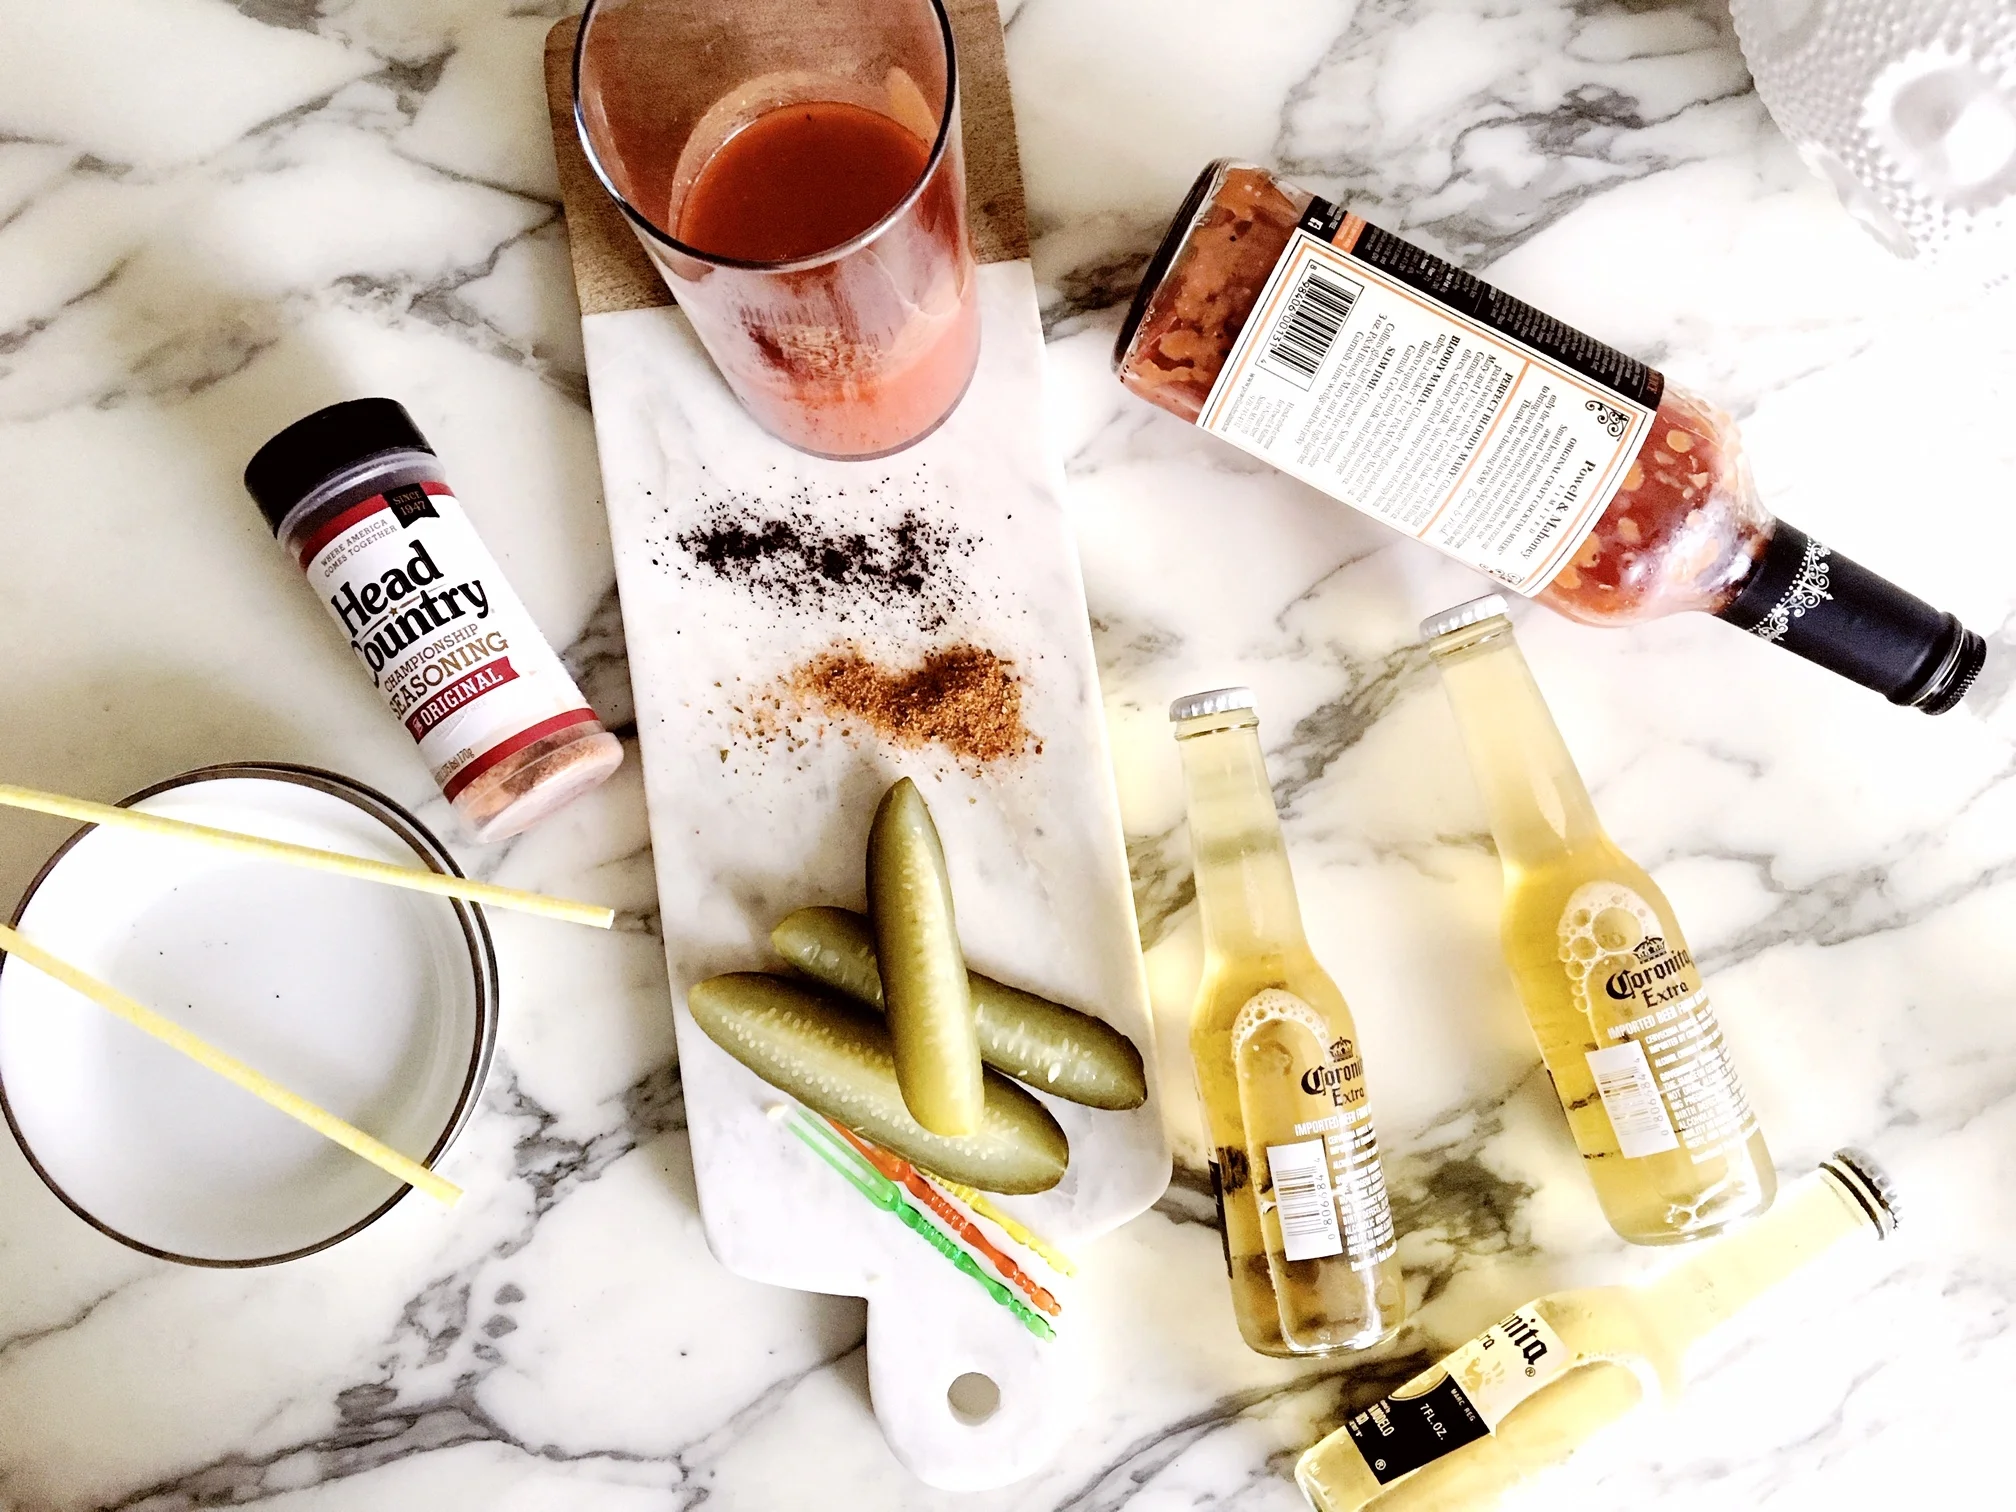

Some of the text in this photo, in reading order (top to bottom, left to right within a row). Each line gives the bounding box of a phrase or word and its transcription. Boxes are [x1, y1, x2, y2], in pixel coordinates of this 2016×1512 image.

[1287, 279, 1310, 314] 98406
[1268, 314, 1292, 349] 00131
[1371, 318, 1382, 331] oz.
[1374, 322, 1395, 350] Collins
[1341, 331, 1365, 364] Garnish:
[1360, 330, 1377, 353] P&M
[1412, 340, 1431, 366] blanco
[1343, 352, 1366, 380] Bloody
[1364, 347, 1380, 369] glass
[1377, 345, 1396, 370] SLIM
[1425, 356, 1436, 366] In
[1435, 335, 1461, 373] BLOODY
[1454, 348, 1473, 373] olives,
[1478, 354, 1497, 374] Mary
[1331, 363, 1347, 384] Lime
[1463, 350, 1485, 383] Garnish:
[1484, 364, 1504, 392] packed
[1332, 379, 1350, 400] Mary
[1364, 369, 1383, 393] JIMI:
[1377, 376, 1399, 402] Celery
[1416, 371, 1441, 408] MARIA:
[1472, 372, 1486, 389] and
[1541, 385, 1550, 395] to
[1318, 382, 1336, 407] wedge
[1447, 380, 1469, 407] Celery
[1474, 390, 1490, 410] with
[1529, 392, 1547, 413] bring
[1543, 394, 1559, 411] only
[1310, 405, 1324, 419] and
[1326, 398, 1340, 415] and
[1336, 401, 1351, 420] with
[1369, 400, 1385, 420] stalk
[1381, 393, 1403, 420] Gently
[1426, 397, 1445, 424] grilled
[1468, 408, 1479, 420] ice
[1512, 398, 1532, 425] Thanks
[1524, 410, 1536, 425] you
[1538, 410, 1550, 422] the
[1330, 417, 1341, 429] ice
[1385, 417, 1402, 439] P&M
[1427, 426, 1443, 444] slice
[1445, 372, 1513, 481] PERFECT BLOODY MARY:
[1505, 424, 1518, 436] for
[1518, 425, 1530, 438] the
[1527, 421, 1544, 443] finest
[1551, 424, 1569, 446] Small
[1409, 422, 1432, 449] shrimp
[1422, 442, 1433, 452] of
[1507, 436, 1523, 456] most
[1369, 437, 1391, 461] Bloody
[1427, 438, 1449, 464] Gently
[1448, 444, 1459, 454] In
[1486, 435, 1511, 466] choosing
[1539, 444, 1557, 466] kettle
[1488, 455, 1513, 486] delicious
[1504, 441, 1533, 482] ingredients
[1491, 487, 1503, 500] our
[1499, 480, 1509, 489] in
[1502, 478, 1523, 505] cocktail
[1513, 437, 1577, 534] ORIGINAL CRAFT COCKTAIL
[1516, 463, 1545, 503] production
[393, 490, 422, 505] SINCE
[400, 500, 426, 515] 1947
[1512, 500, 1522, 508] is
[1504, 506, 1519, 521] how
[1520, 459, 1596, 562] Powell & Mahoney
[320, 519, 388, 567] WHERE AMERICA
[324, 524, 398, 577] COMES TOGETHER
[331, 539, 444, 638] Head
[351, 580, 487, 688] Country
[384, 622, 478, 692] CHAMPIONSHIP
[389, 631, 509, 720] SEASONING
[420, 667, 504, 726] ORIGINAL
[456, 746, 475, 763] 170g
[1606, 948, 1695, 999] Coronita
[1642, 980, 1689, 1008] Extra
[1607, 1014, 1657, 1040] IMPORTED
[1332, 1087, 1364, 1107] Extra
[1294, 1116, 1340, 1137] IMPORTED
[1497, 1313, 1548, 1365] nita
[1450, 1388, 1465, 1406] MARC
